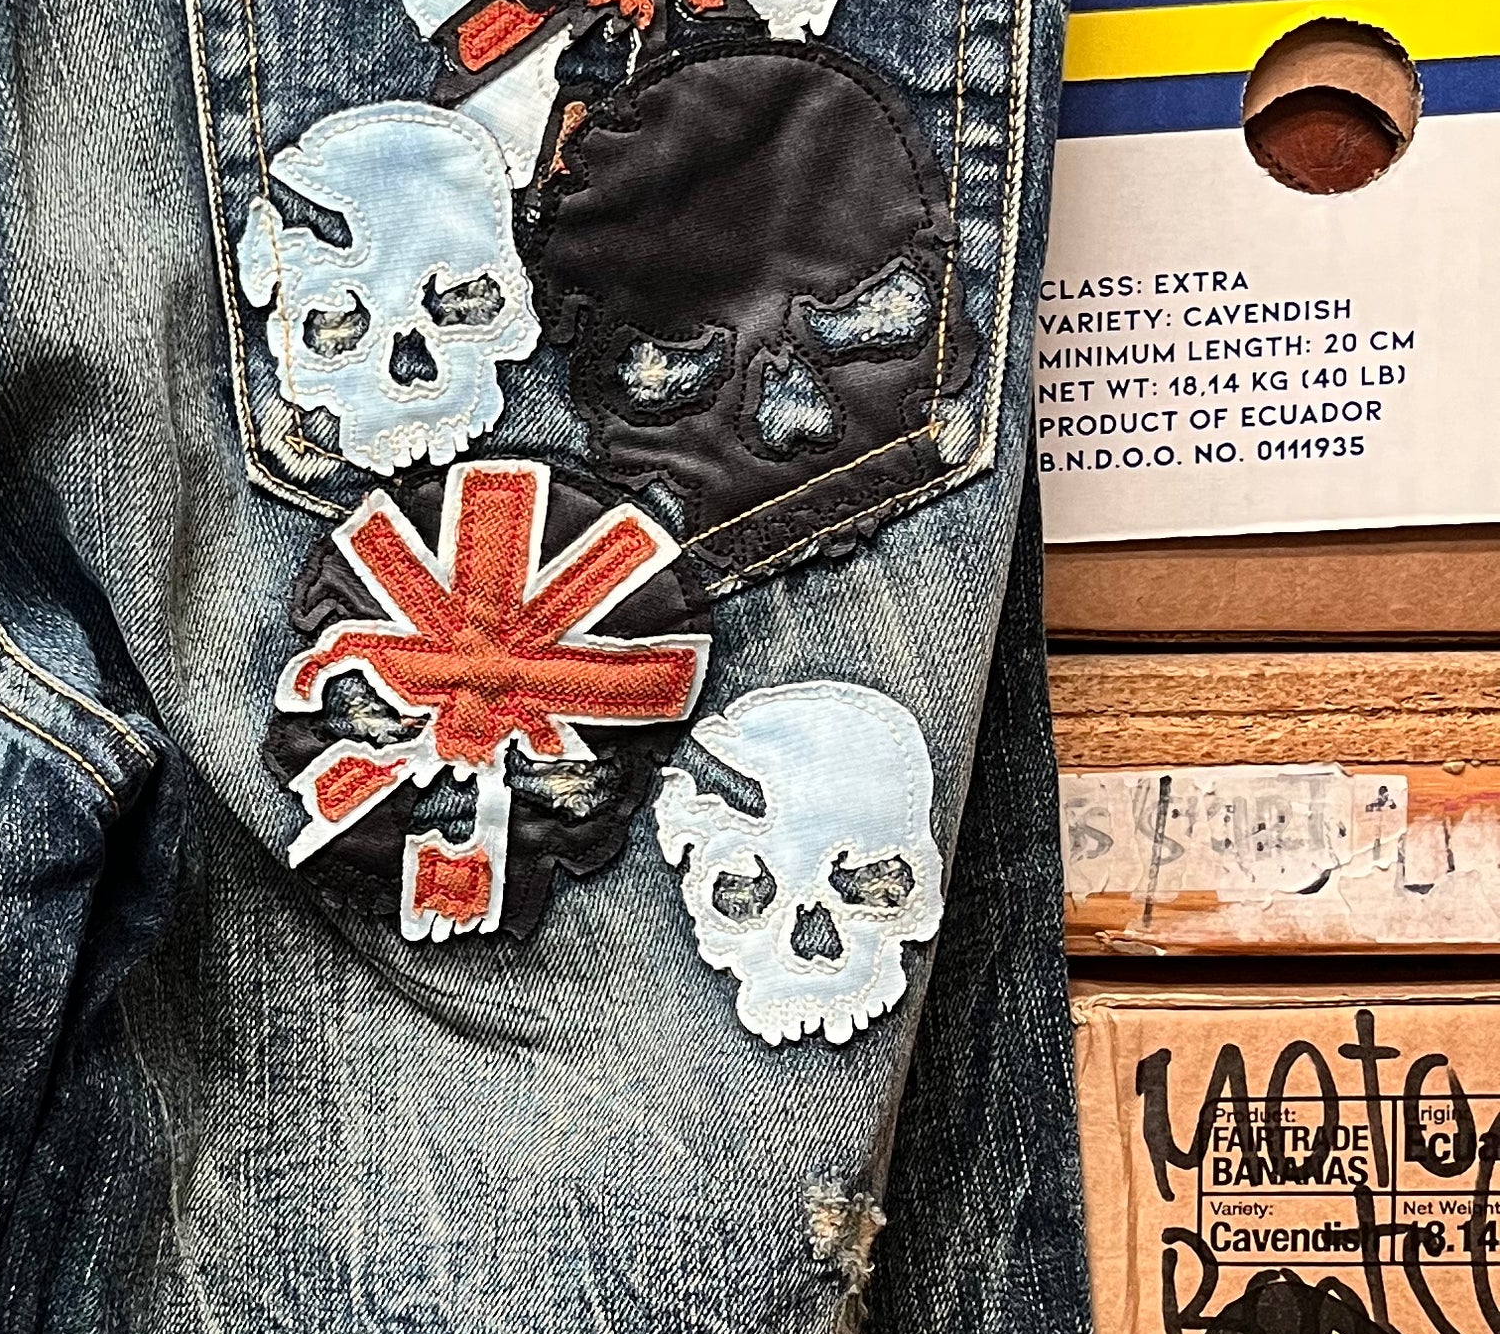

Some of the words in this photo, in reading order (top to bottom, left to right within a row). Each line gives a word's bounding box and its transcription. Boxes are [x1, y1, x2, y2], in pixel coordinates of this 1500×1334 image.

[1039, 275, 1142, 301] CLASS:
[1155, 271, 1249, 295] EXTRA
[1038, 308, 1171, 335] VARIETY:
[1183, 299, 1351, 327] CAVENDISH
[1039, 342, 1175, 369] MINIMUM
[1188, 335, 1311, 362] LENGTH:
[1324, 333, 1357, 354] 20
[1369, 330, 1415, 351] CM
[1039, 380, 1095, 404] NET
[1106, 377, 1158, 400] WT:
[1169, 373, 1240, 397] 18,14
[1252, 370, 1288, 392] KG
[1301, 367, 1347, 389] (40
[1361, 364, 1406, 386] LB)
[1039, 410, 1178, 439] PRODUCT
[1189, 408, 1228, 430] OF
[1241, 400, 1382, 428] ECUADOR
[1040, 445, 1183, 473] B.N.D.O.O.
[1195, 442, 1244, 464] NO.
[1257, 435, 1365, 461] 0111935
[1213, 1125, 1369, 1152] FAIRTRADE
[1213, 1156, 1369, 1186] BANANAS
[1210, 1201, 1274, 1219] Variety:
[1403, 1201, 1433, 1215] Net
